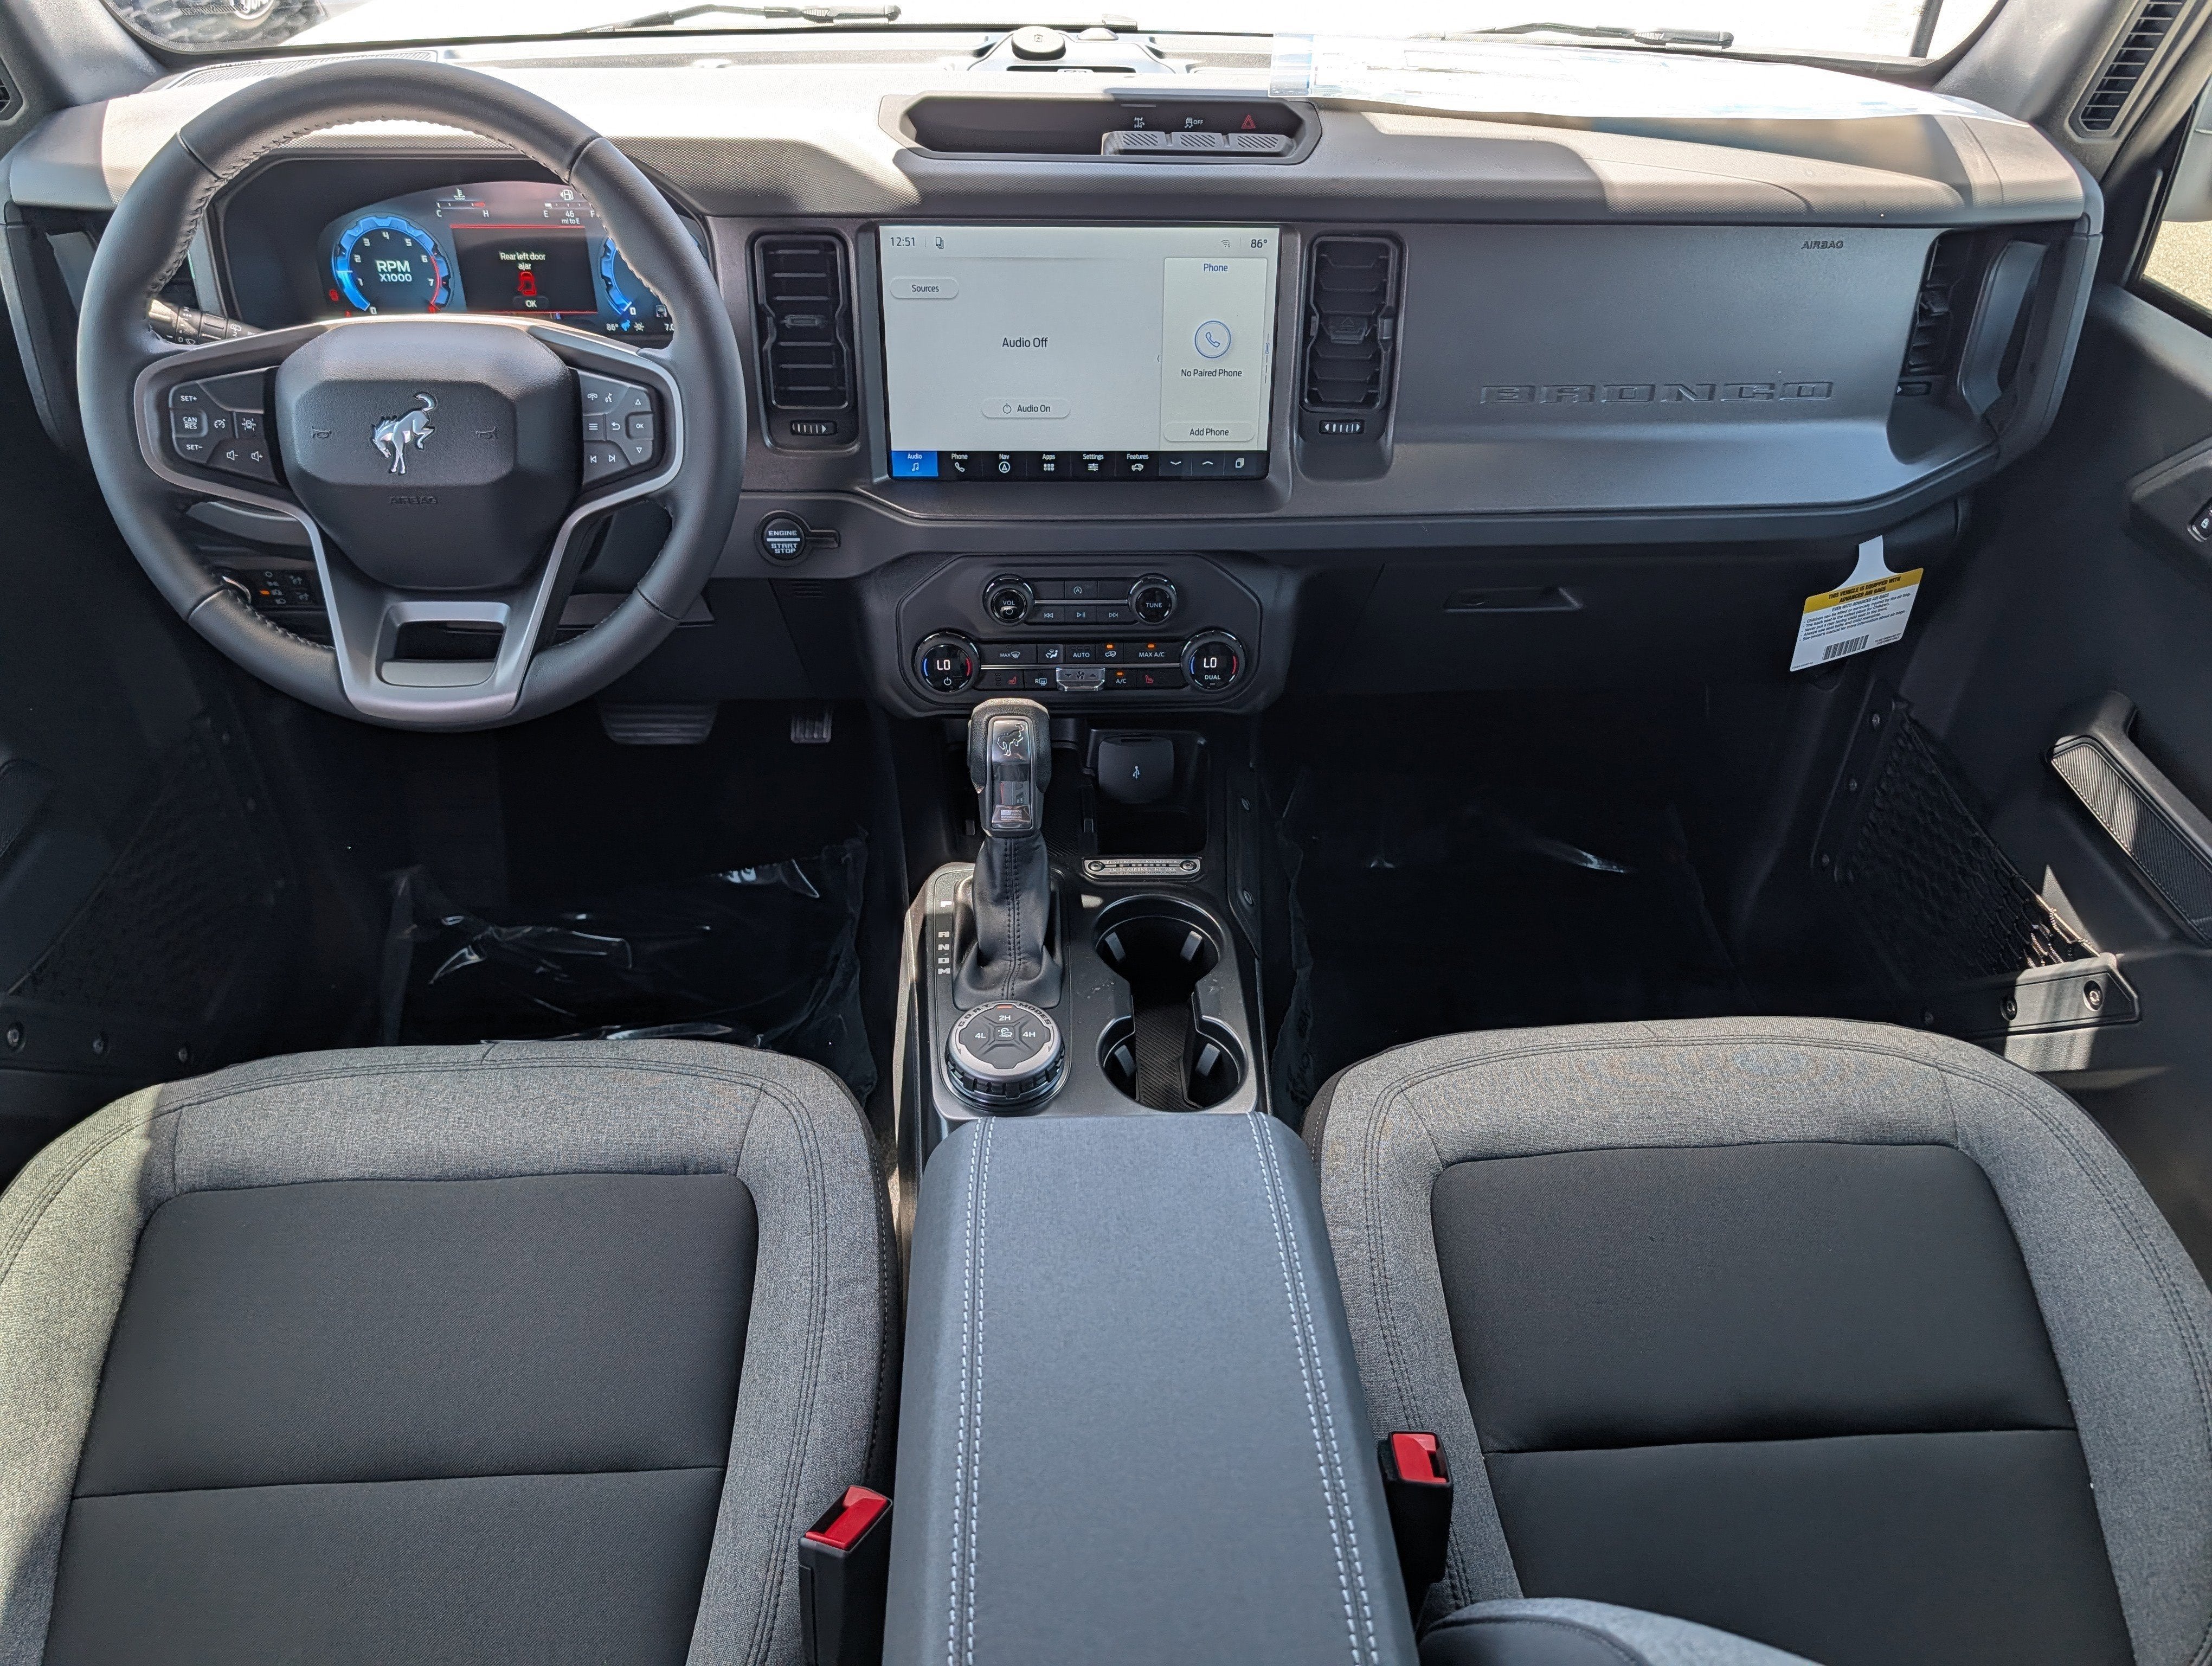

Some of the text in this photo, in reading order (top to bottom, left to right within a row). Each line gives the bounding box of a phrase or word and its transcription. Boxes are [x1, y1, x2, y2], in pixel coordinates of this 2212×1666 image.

[436, 209, 442, 218] C
[483, 209, 490, 218] H
[543, 210, 549, 218] E
[565, 209, 575, 218] 46
[589, 210, 596, 218] F
[382, 232, 390, 240] 4
[363, 238, 371, 247] 3
[404, 238, 413, 247] 5
[890, 236, 916, 247] 12:51
[1801, 240, 1844, 250] AIRBAG
[354, 254, 362, 263] 2
[420, 254, 428, 263] 6
[499, 251, 546, 261] Rear left door
[375, 260, 411, 273] RPM
[518, 262, 532, 271] ajar
[1203, 263, 1229, 272] Phone
[357, 277, 364, 286] 1
[379, 273, 413, 283] X1000
[427, 278, 434, 287] 7
[911, 284, 940, 293] Sources
[524, 299, 538, 309] OK
[370, 306, 377, 315] 0
[629, 306, 637, 316] 0
[1002, 337, 1049, 348] Audio Off
[1180, 368, 1243, 377] No Paired Phone
[1479, 382, 1834, 404] BRONCO
[1017, 404, 1051, 413] Audio On
[1189, 428, 1230, 437] Add Phone
[1042, 453, 1056, 462] Apps
[1082, 453, 1104, 462] Settings
[936, 659, 951, 671] LO
[1203, 657, 1218, 669] LO
[1018, 1003, 1053, 1026] MODES
